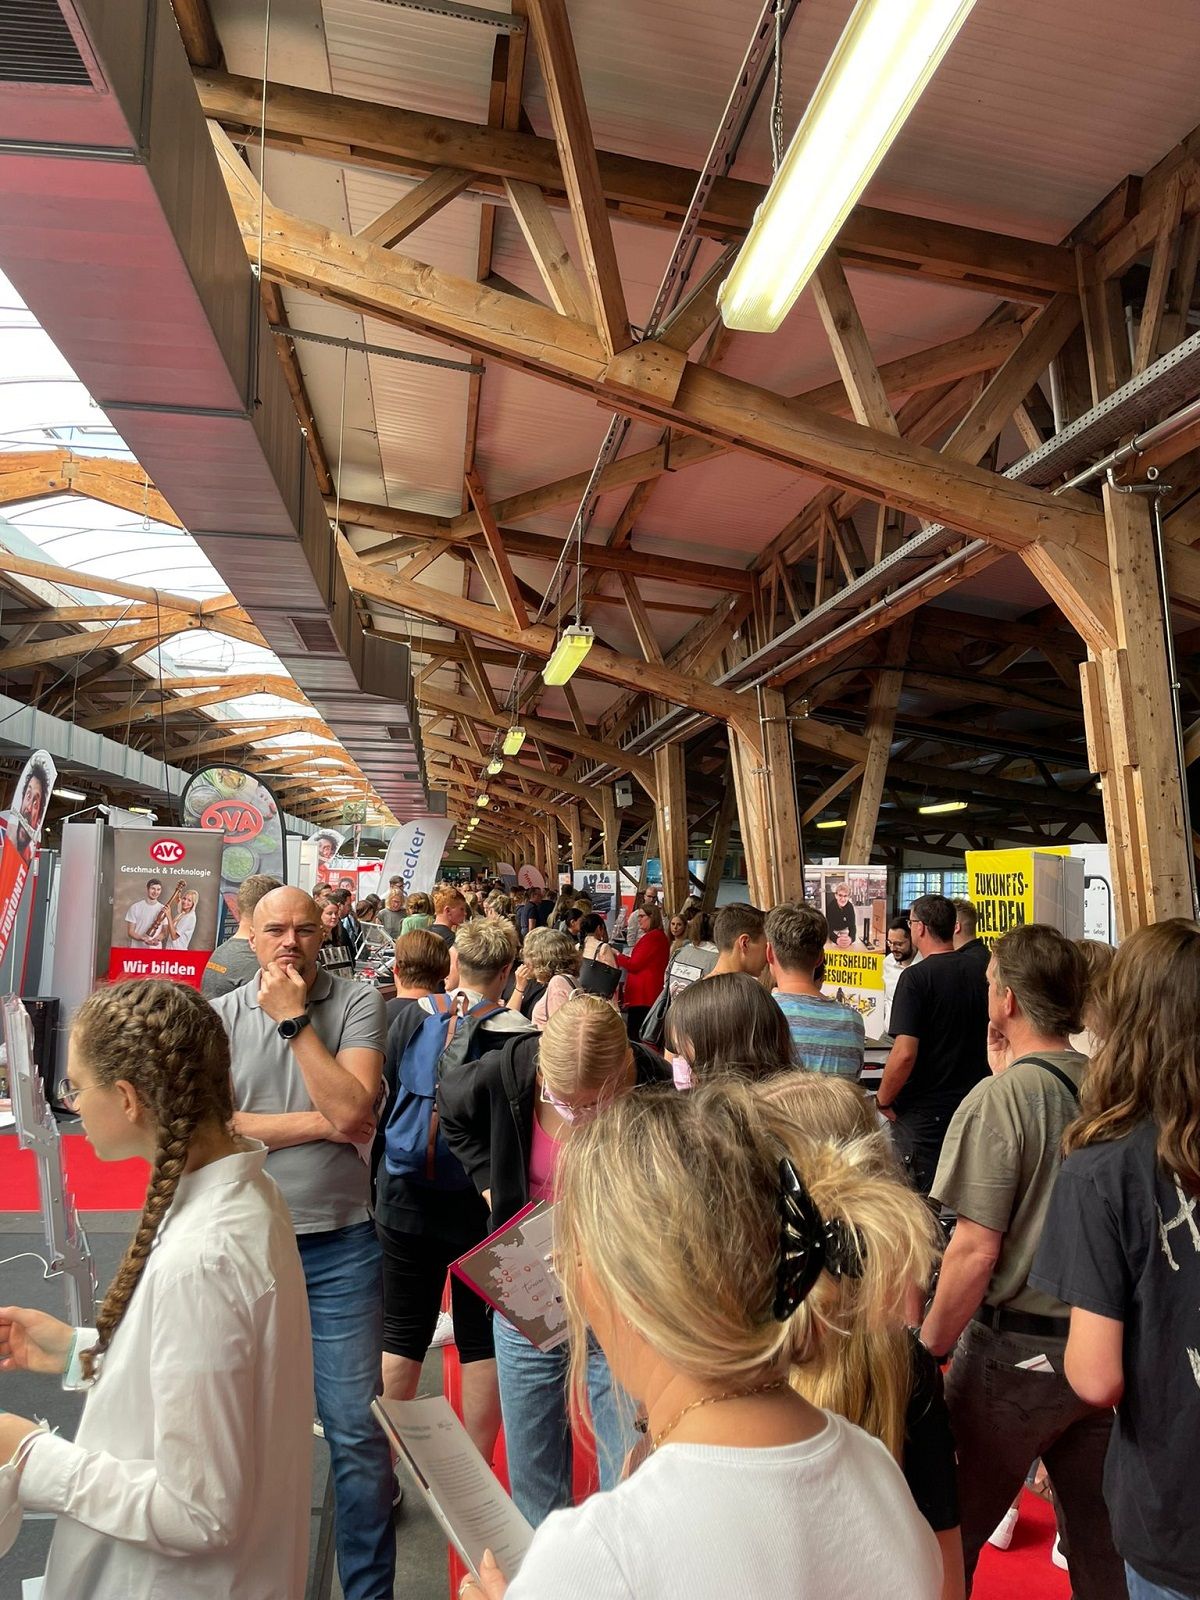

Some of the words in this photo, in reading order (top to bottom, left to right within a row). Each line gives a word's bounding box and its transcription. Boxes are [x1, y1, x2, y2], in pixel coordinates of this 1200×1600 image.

[121, 865, 160, 875] Geschmack
[170, 867, 212, 877] Technologie
[403, 827, 426, 896] secker
[974, 872, 1029, 896] ZUKUNFTS-
[1, 864, 27, 939] ZUKUNFT
[976, 900, 1026, 932] HELDEN
[123, 960, 148, 974] Wir
[151, 961, 196, 976] bilden
[824, 953, 878, 971] UNFTSHELDEN
